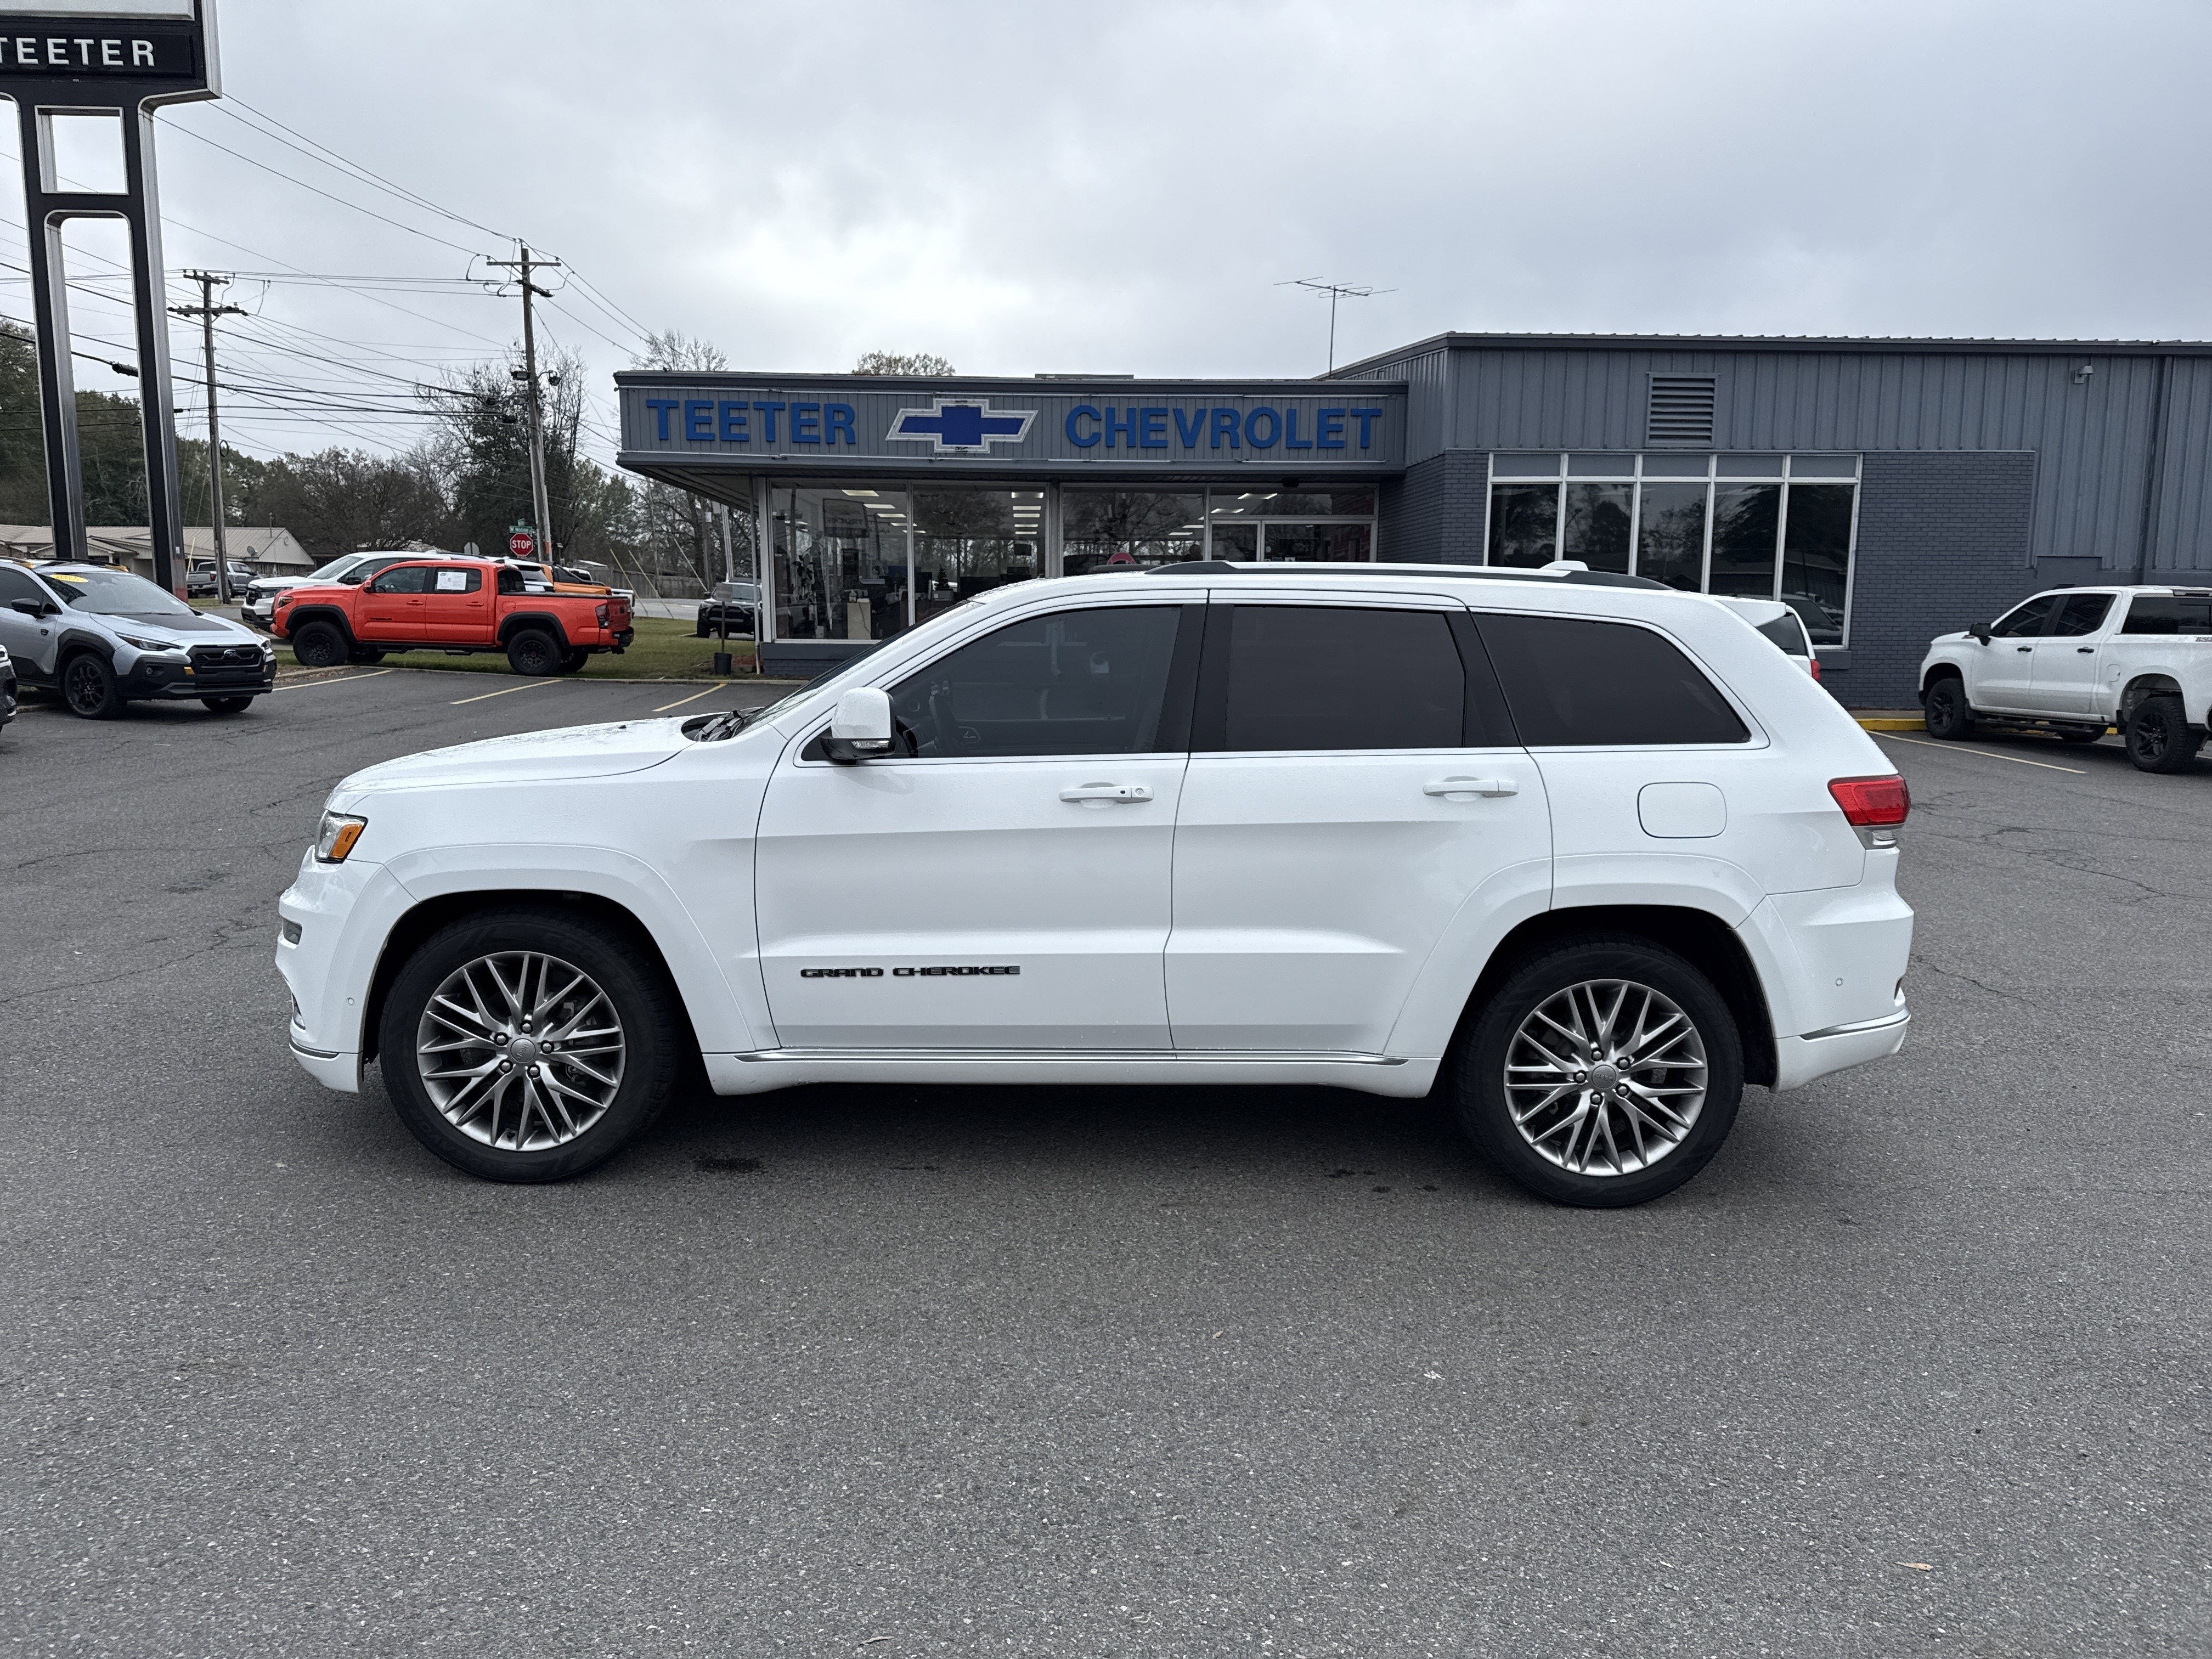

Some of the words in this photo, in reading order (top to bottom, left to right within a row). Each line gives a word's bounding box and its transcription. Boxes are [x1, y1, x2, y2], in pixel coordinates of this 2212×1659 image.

[646, 399, 856, 444] TEETER
[1065, 404, 1383, 449] CHEVROLET
[512, 540, 532, 549] STOP
[800, 968, 884, 977] GRAND
[893, 966, 1020, 976] CHEROKEE
